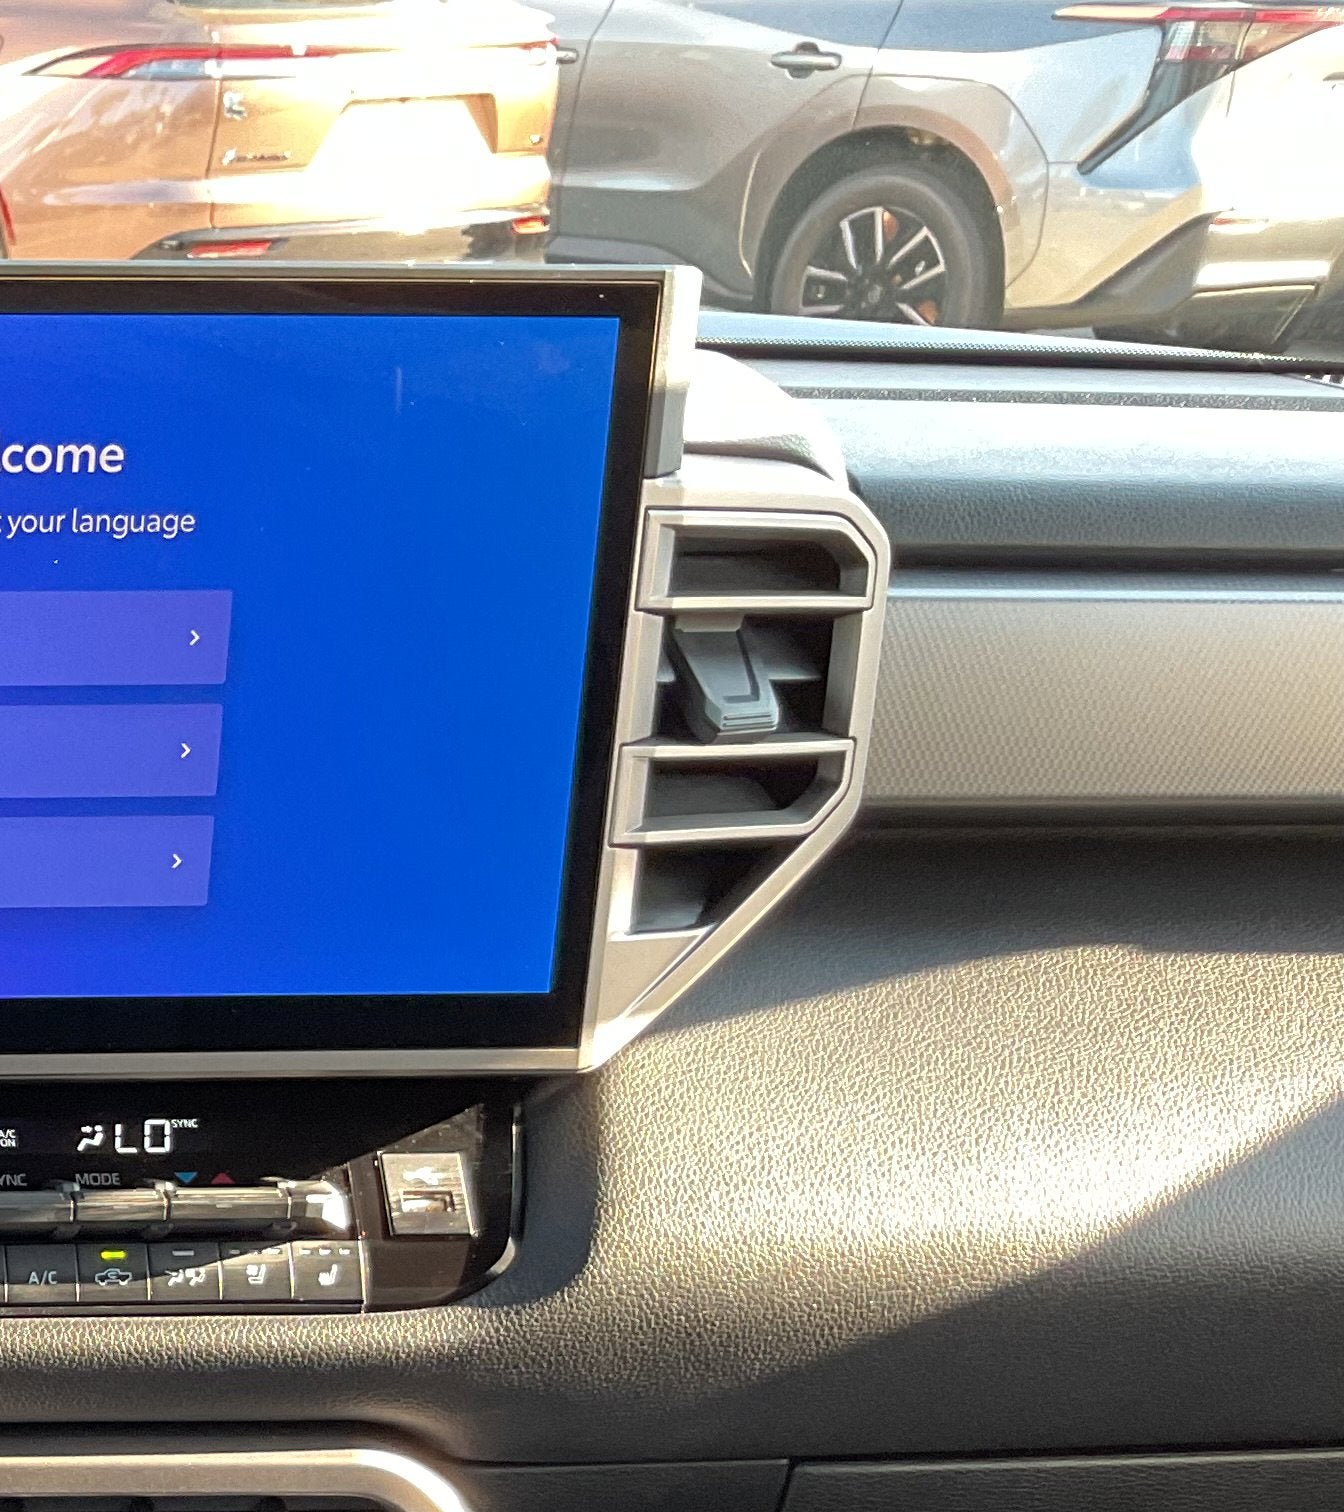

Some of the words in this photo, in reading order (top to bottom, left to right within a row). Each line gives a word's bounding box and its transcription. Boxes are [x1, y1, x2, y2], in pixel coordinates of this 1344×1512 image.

[6, 512, 65, 538] your
[71, 509, 196, 539] language
[171, 1118, 199, 1129] SYNC
[0, 1138, 17, 1148] ON
[114, 1118, 172, 1155] LO
[75, 1172, 122, 1187] MODE
[28, 1269, 58, 1286] A/C
